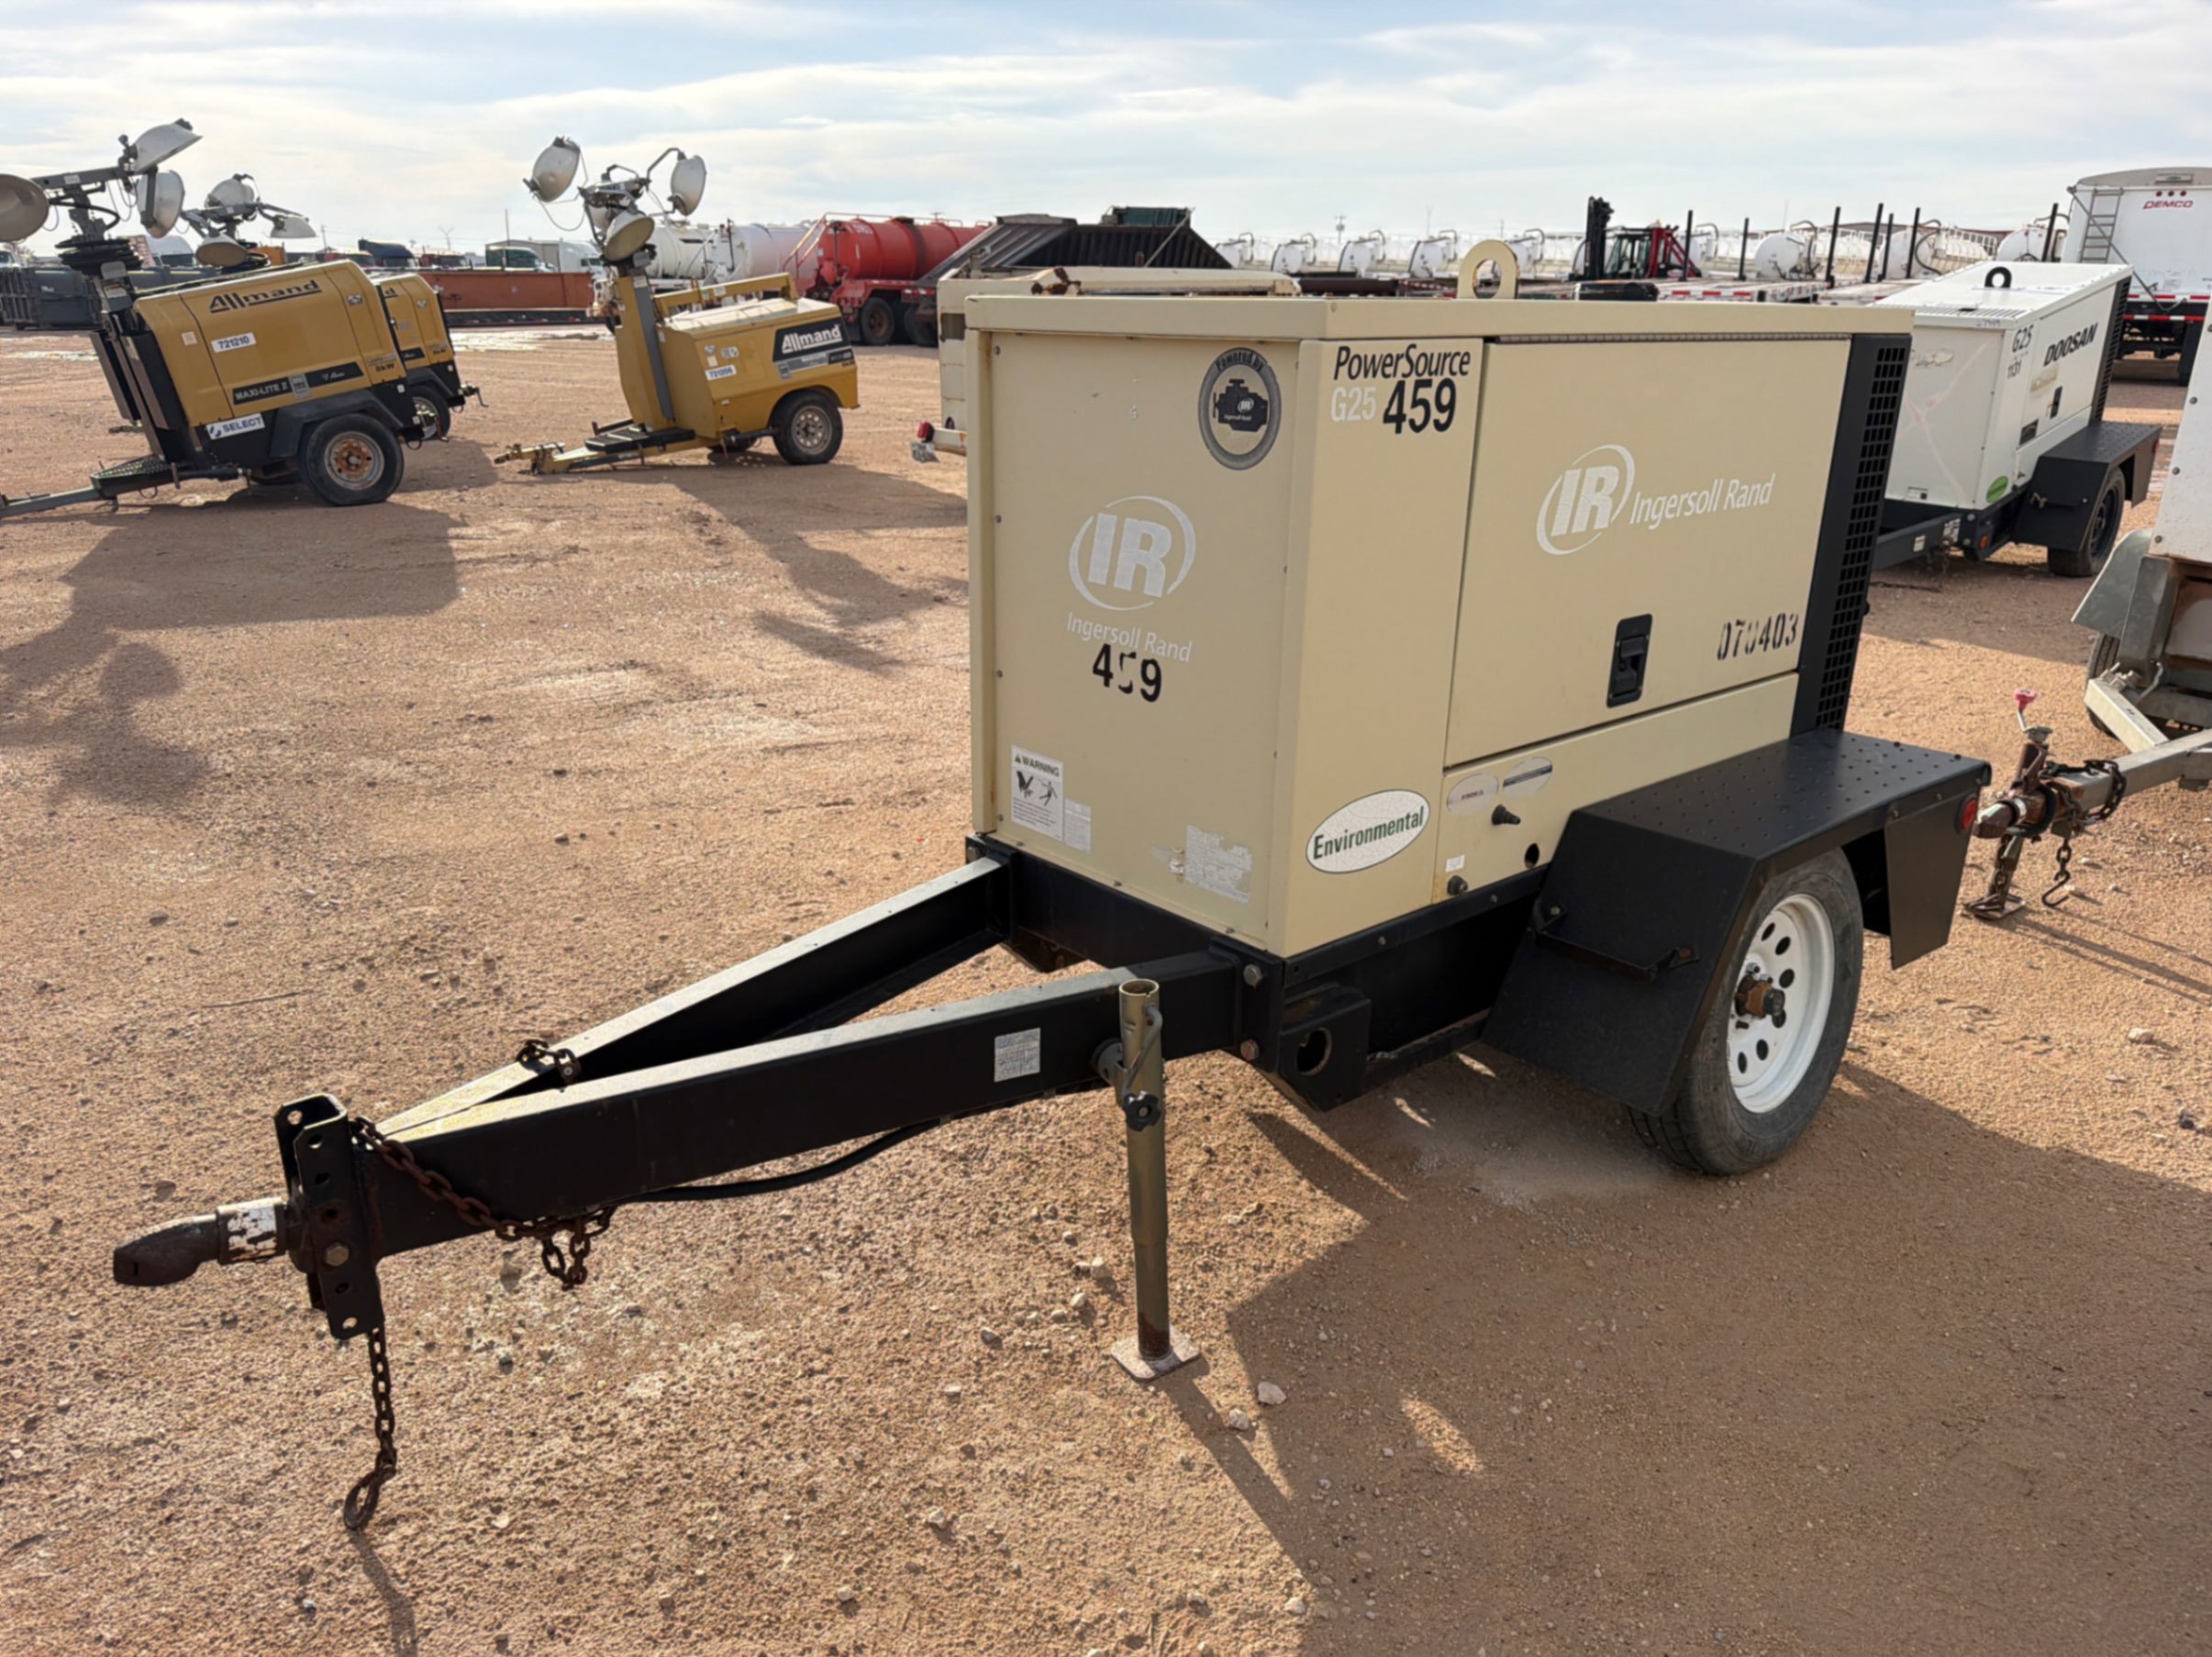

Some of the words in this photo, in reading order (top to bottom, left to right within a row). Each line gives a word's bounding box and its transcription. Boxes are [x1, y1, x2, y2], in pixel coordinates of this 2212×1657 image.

[2143, 200, 2194, 209] DEMCO
[210, 280, 322, 313] Allmand
[218, 336, 250, 350] 721210
[782, 324, 842, 354] Allmand
[2012, 325, 2034, 352] G25
[2043, 322, 2099, 367] DOOSAN
[1333, 343, 1471, 381] PowerSource
[235, 384, 280, 400] MAXI-LITE
[1331, 386, 1376, 422] G25
[1383, 378, 1457, 434] 459
[223, 417, 261, 432] SELECT
[1551, 465, 1620, 537] IR
[1629, 478, 1724, 530] Ingersoll
[1723, 472, 1776, 511] Rand
[1088, 512, 1173, 597] IR
[1067, 612, 1141, 650] Ingersoll
[1144, 631, 1193, 662] Rand
[1092, 643, 1162, 703] 459
[1022, 755, 1060, 777] WARNING
[1313, 806, 1424, 860] Environmental
